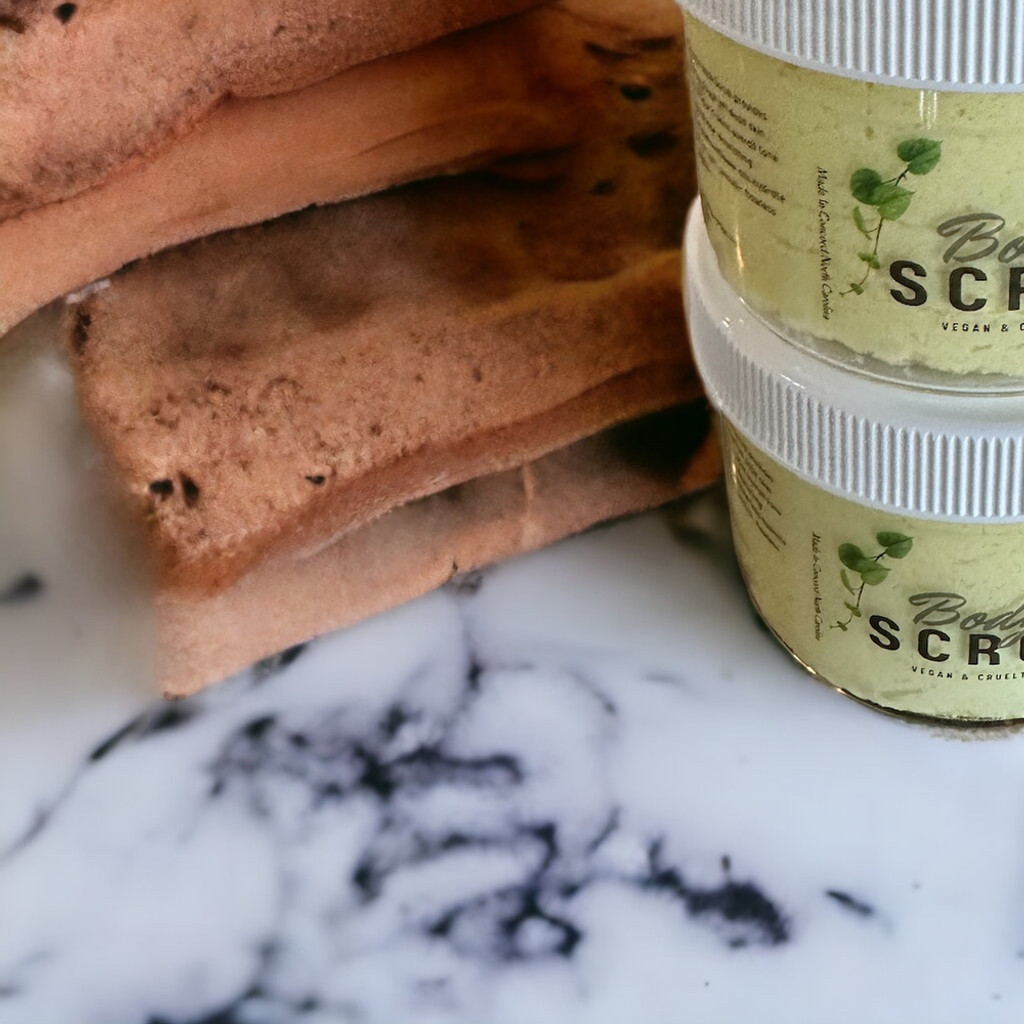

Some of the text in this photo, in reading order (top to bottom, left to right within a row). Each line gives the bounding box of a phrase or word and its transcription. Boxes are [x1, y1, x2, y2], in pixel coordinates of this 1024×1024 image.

[942, 321, 991, 333] VEGAN
[1001, 323, 1010, 332] &
[912, 666, 953, 679] VEGAN
